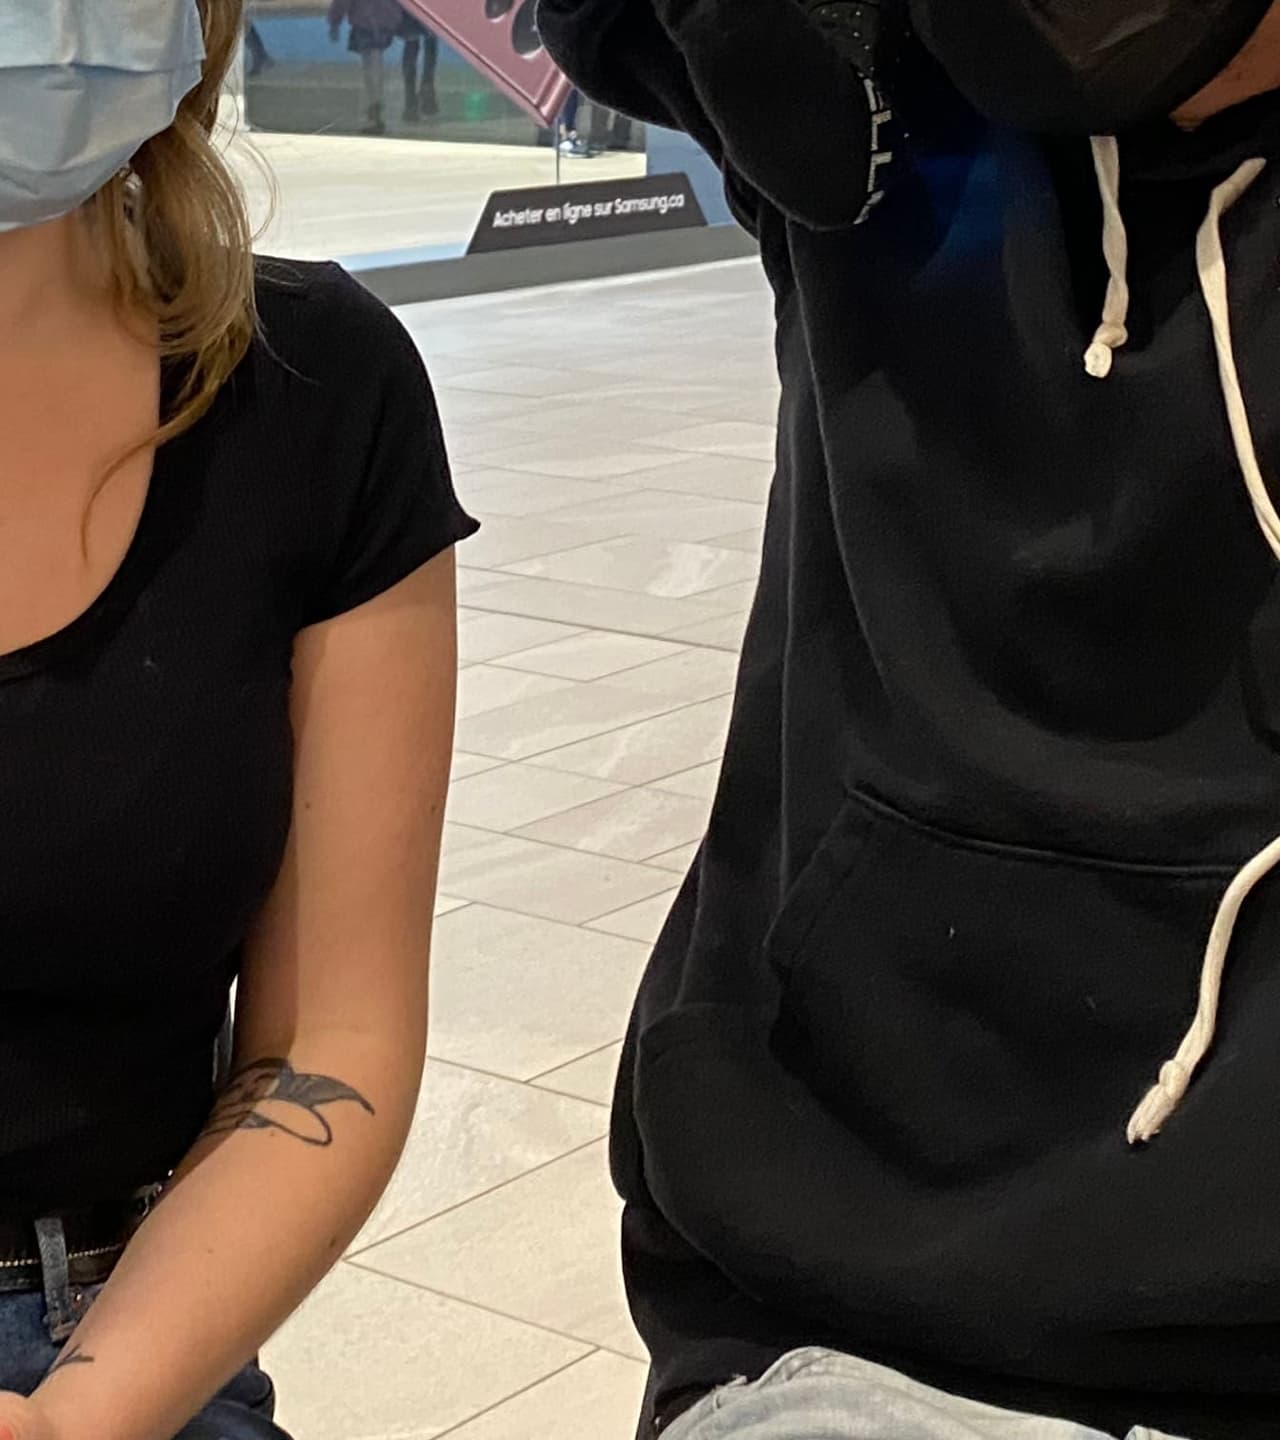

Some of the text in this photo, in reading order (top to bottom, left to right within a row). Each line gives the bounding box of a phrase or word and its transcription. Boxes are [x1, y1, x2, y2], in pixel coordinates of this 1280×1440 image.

[492, 193, 685, 228] Acheter en ligne sur Samsung.ca
